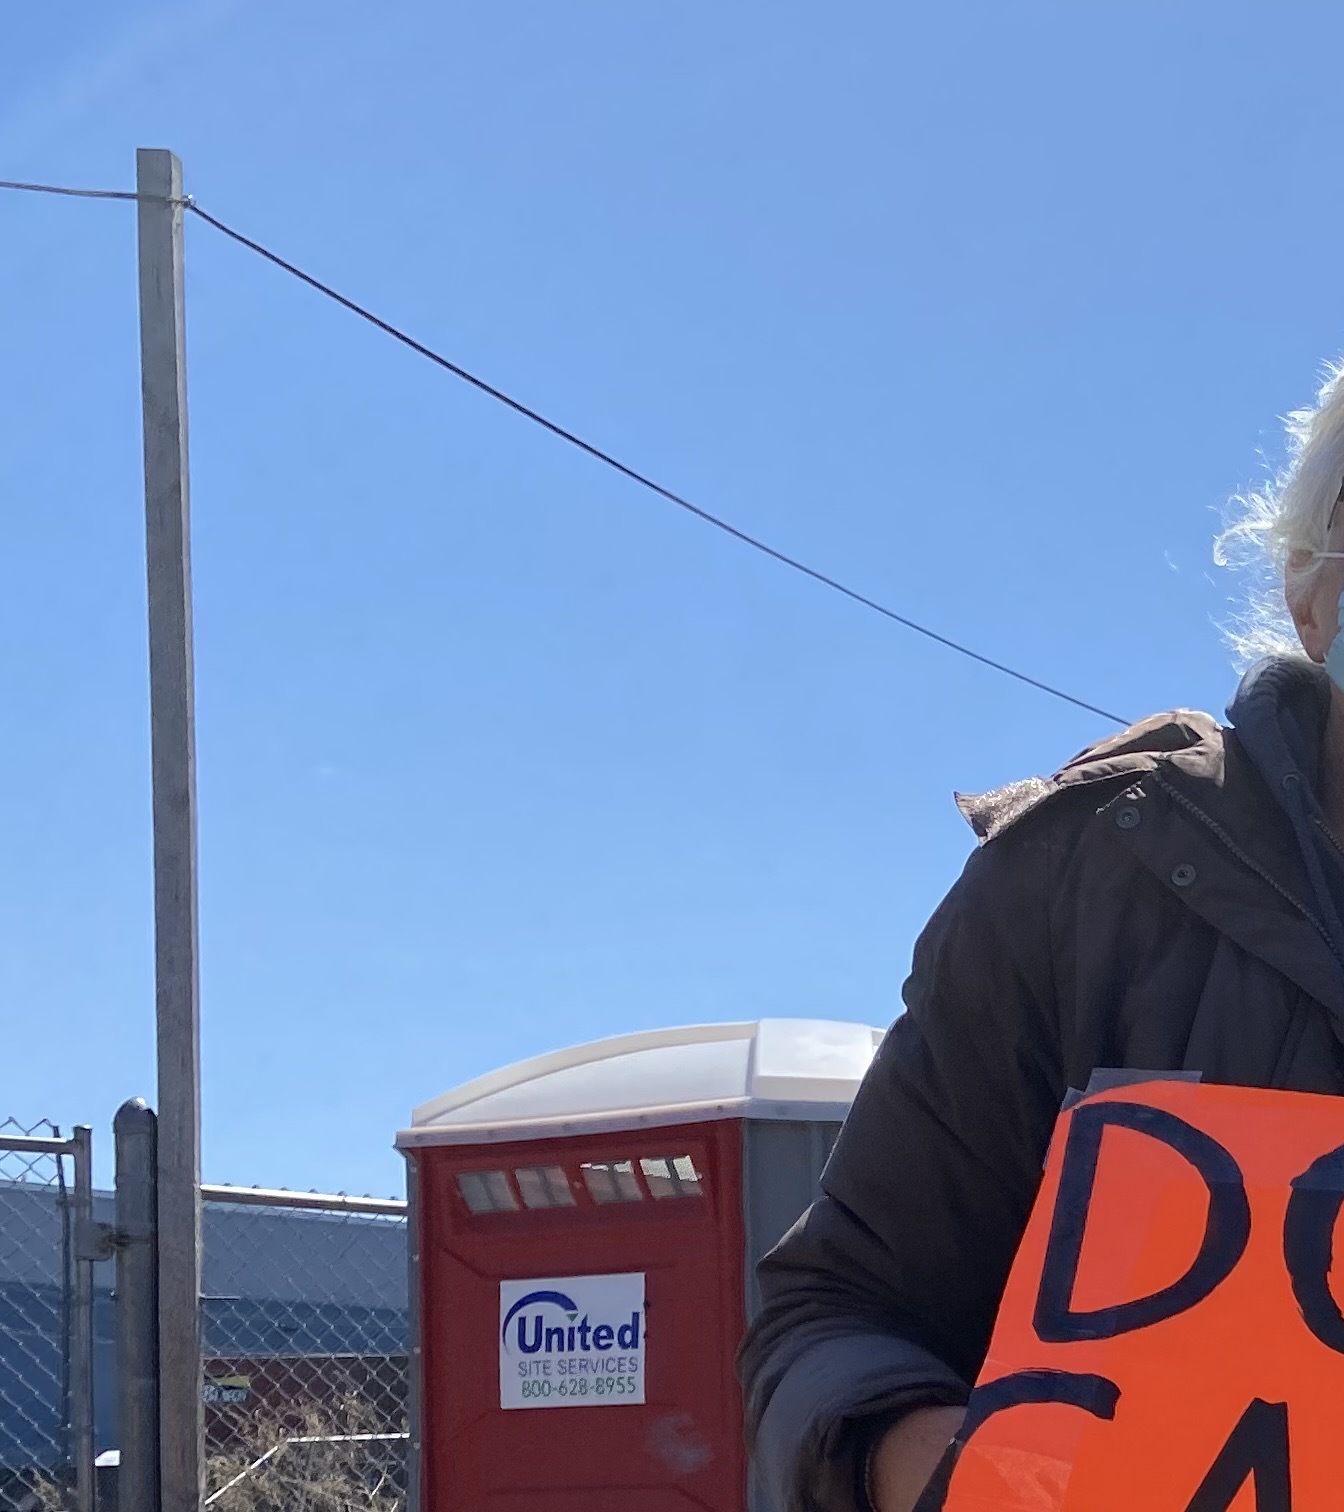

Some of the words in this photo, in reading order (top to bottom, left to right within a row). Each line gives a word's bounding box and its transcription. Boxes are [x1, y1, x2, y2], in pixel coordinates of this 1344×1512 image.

[517, 1312, 640, 1354] United
[518, 1359, 552, 1378] SITE
[557, 1356, 638, 1375] SERVICES
[521, 1375, 637, 1399] 800-628-8955
